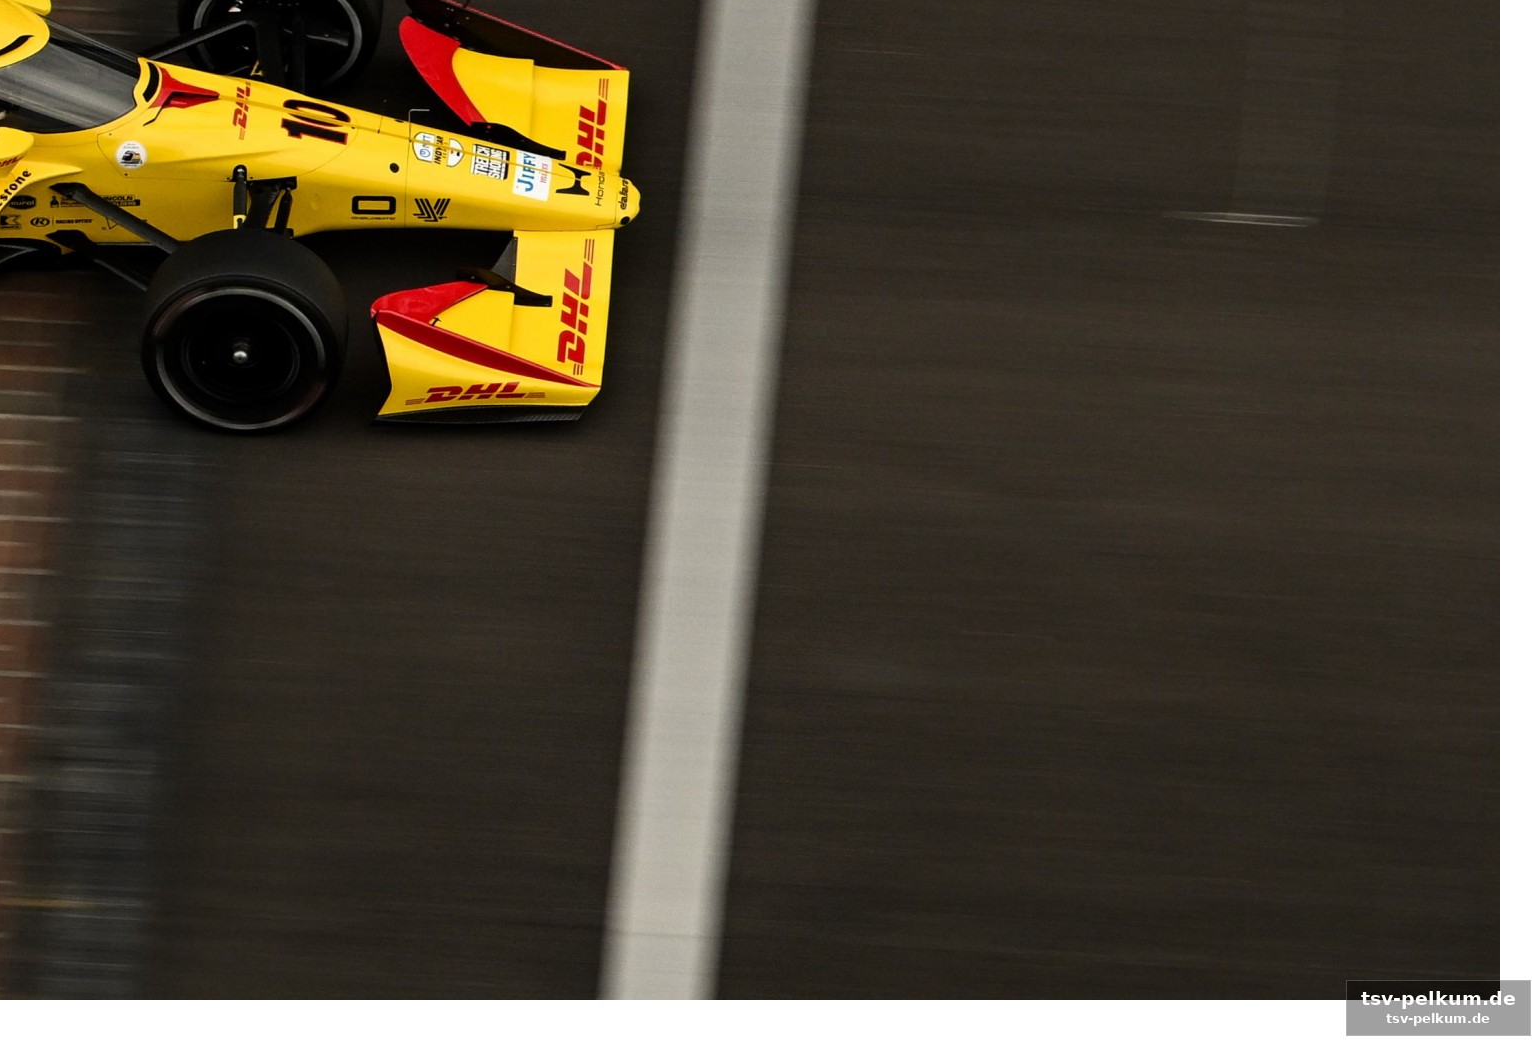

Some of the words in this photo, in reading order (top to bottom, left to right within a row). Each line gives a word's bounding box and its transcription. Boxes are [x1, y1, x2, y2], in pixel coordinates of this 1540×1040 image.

[280, 99, 351, 145] 10
[474, 146, 491, 175] TRECH
[517, 152, 537, 192] JIFFY
[557, 262, 593, 364] DHL
[424, 381, 528, 403] DHL
